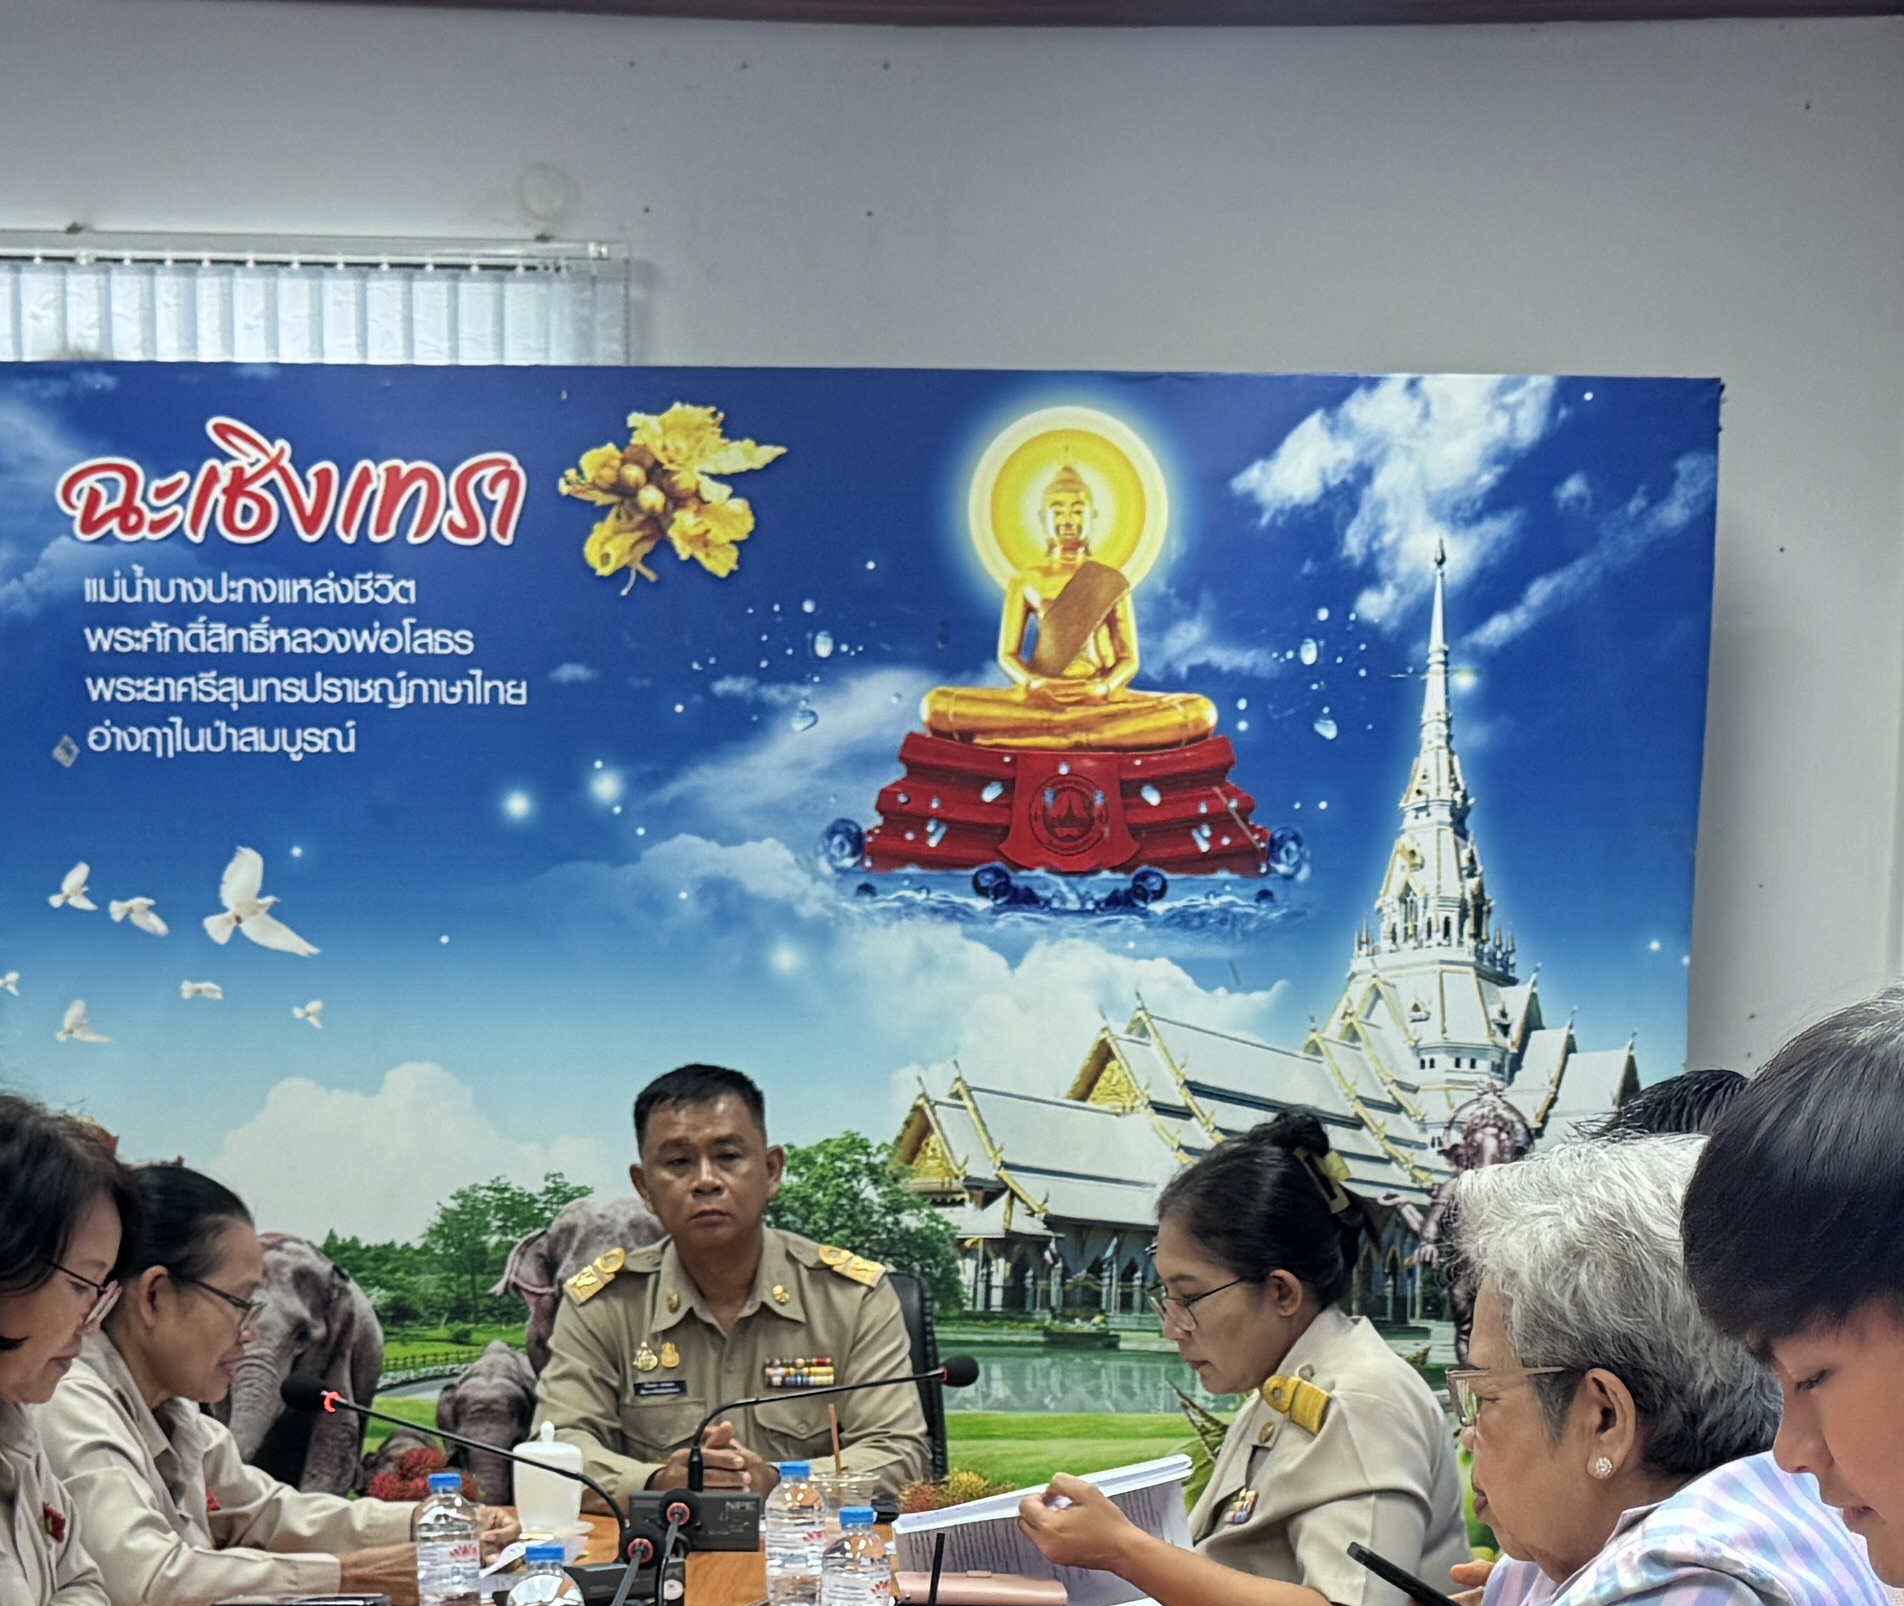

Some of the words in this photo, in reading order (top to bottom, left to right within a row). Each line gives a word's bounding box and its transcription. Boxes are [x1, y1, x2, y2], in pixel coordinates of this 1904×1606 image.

[57, 417, 526, 544] ฉะเชิงเทรา
[84, 564, 416, 604] แม่น้ำบางปะกงแหล่งชีวิต
[84, 615, 475, 655] พระศักดิ์สิทธิ์หลวงพ่อโสธร
[85, 669, 528, 710] พระยาศรีสุนทรปราชญ์ภาษาไทย
